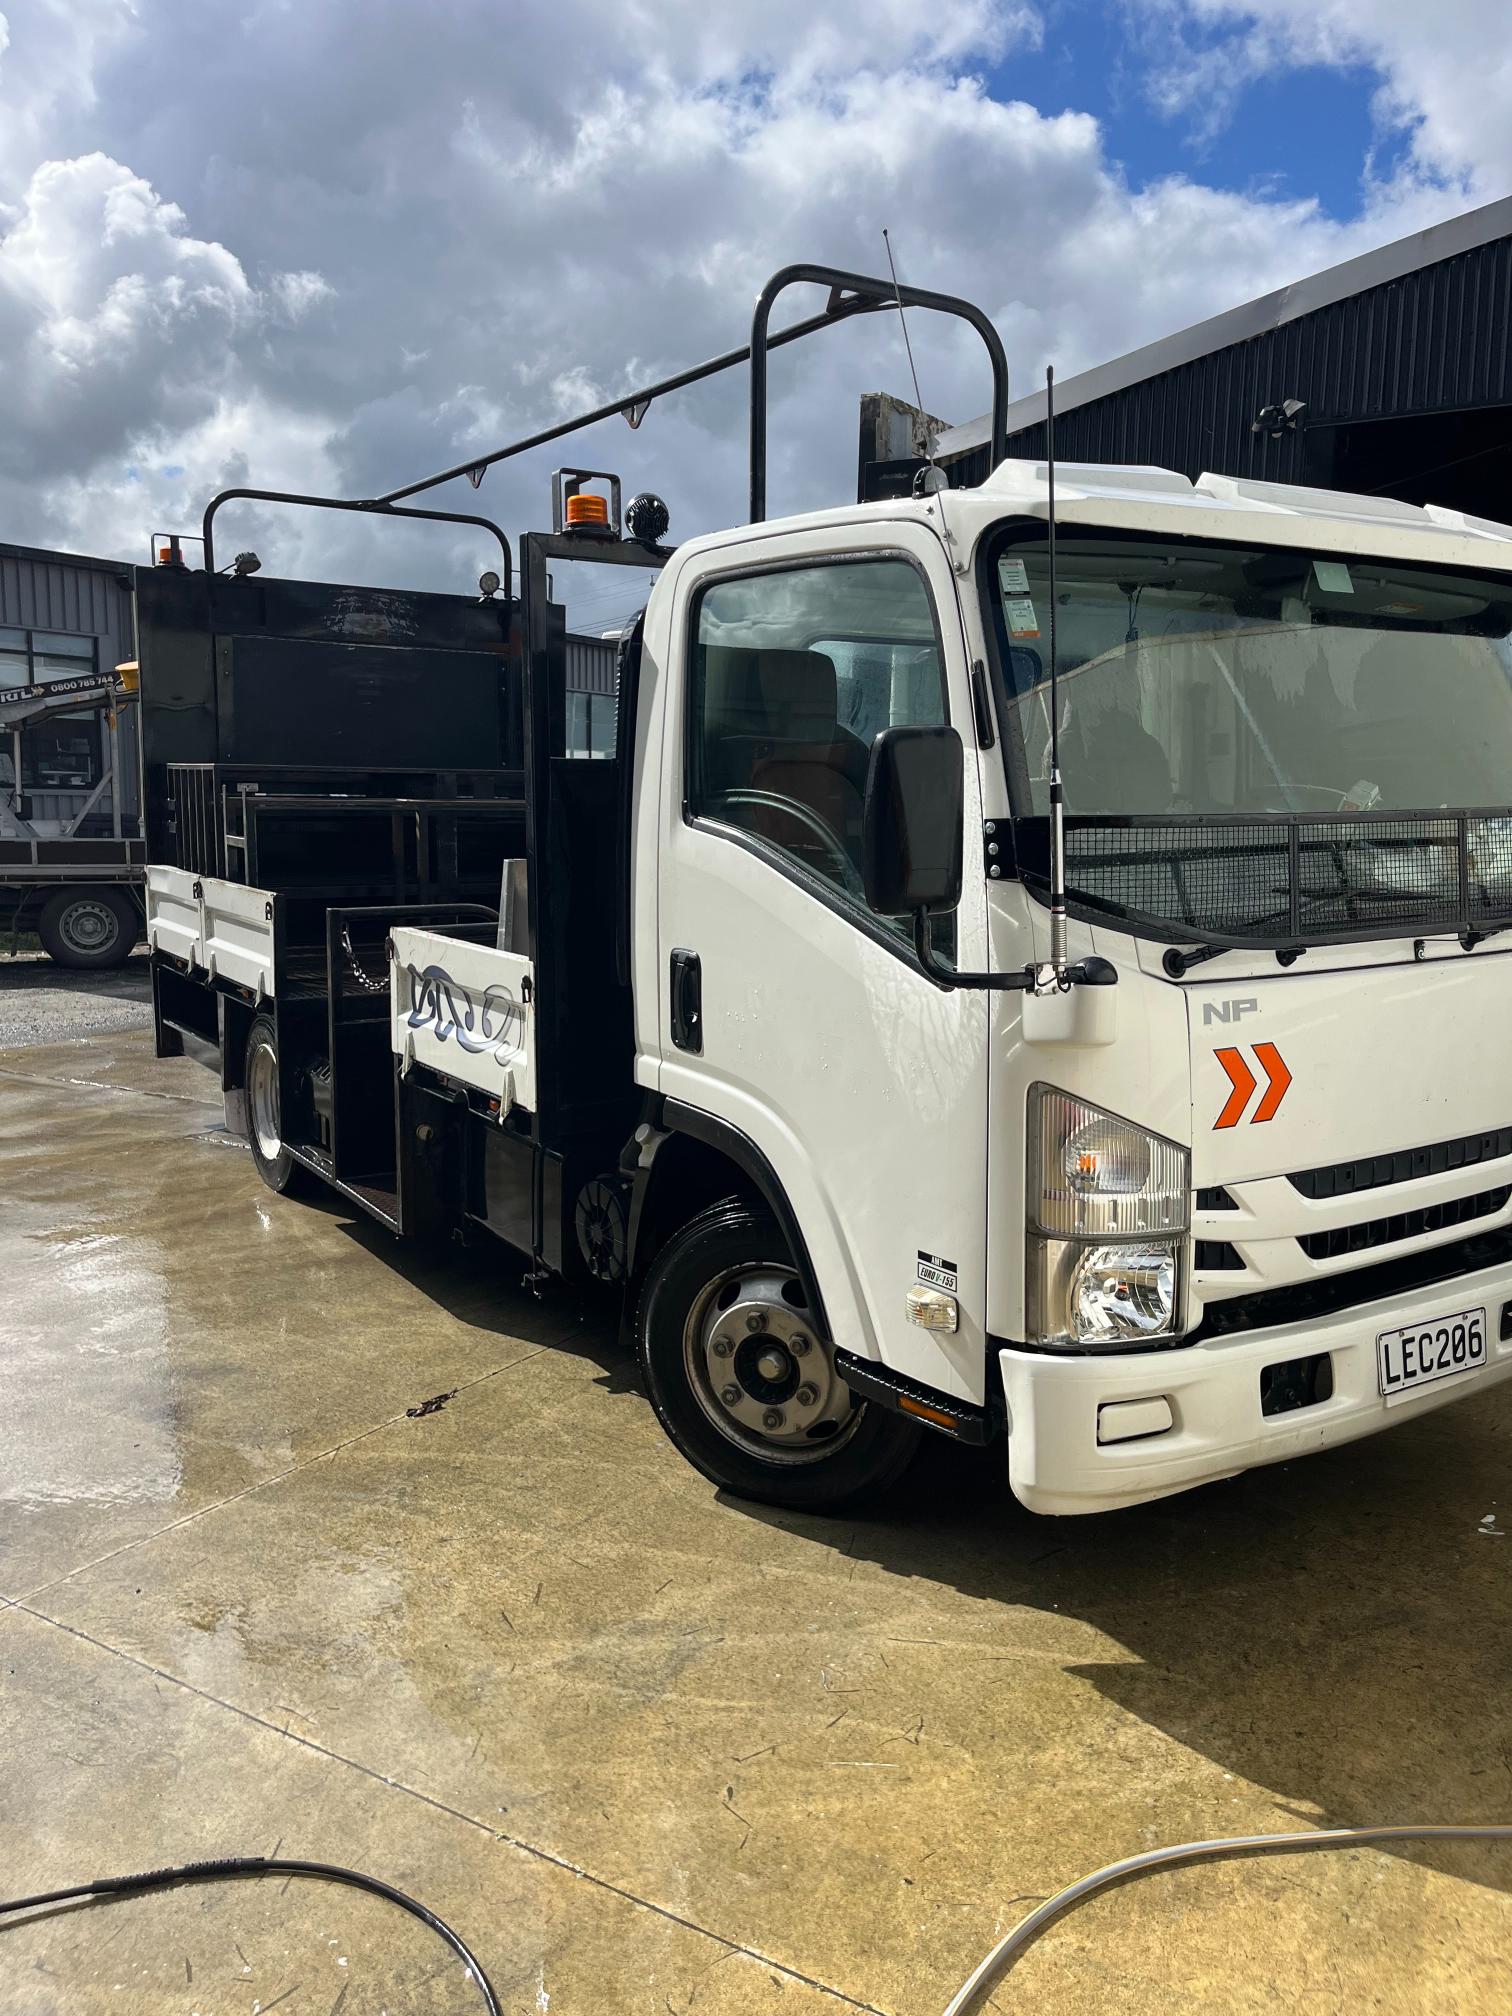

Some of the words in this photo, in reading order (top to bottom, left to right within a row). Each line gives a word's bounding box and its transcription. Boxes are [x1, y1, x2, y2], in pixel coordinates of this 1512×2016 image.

[51, 681, 77, 692] 0800
[79, 678, 95, 688] 785
[1203, 998, 1258, 1025] NP
[920, 1267, 935, 1280] EURO
[935, 1273, 954, 1287] V-155
[1384, 1318, 1483, 1385] LEC206
